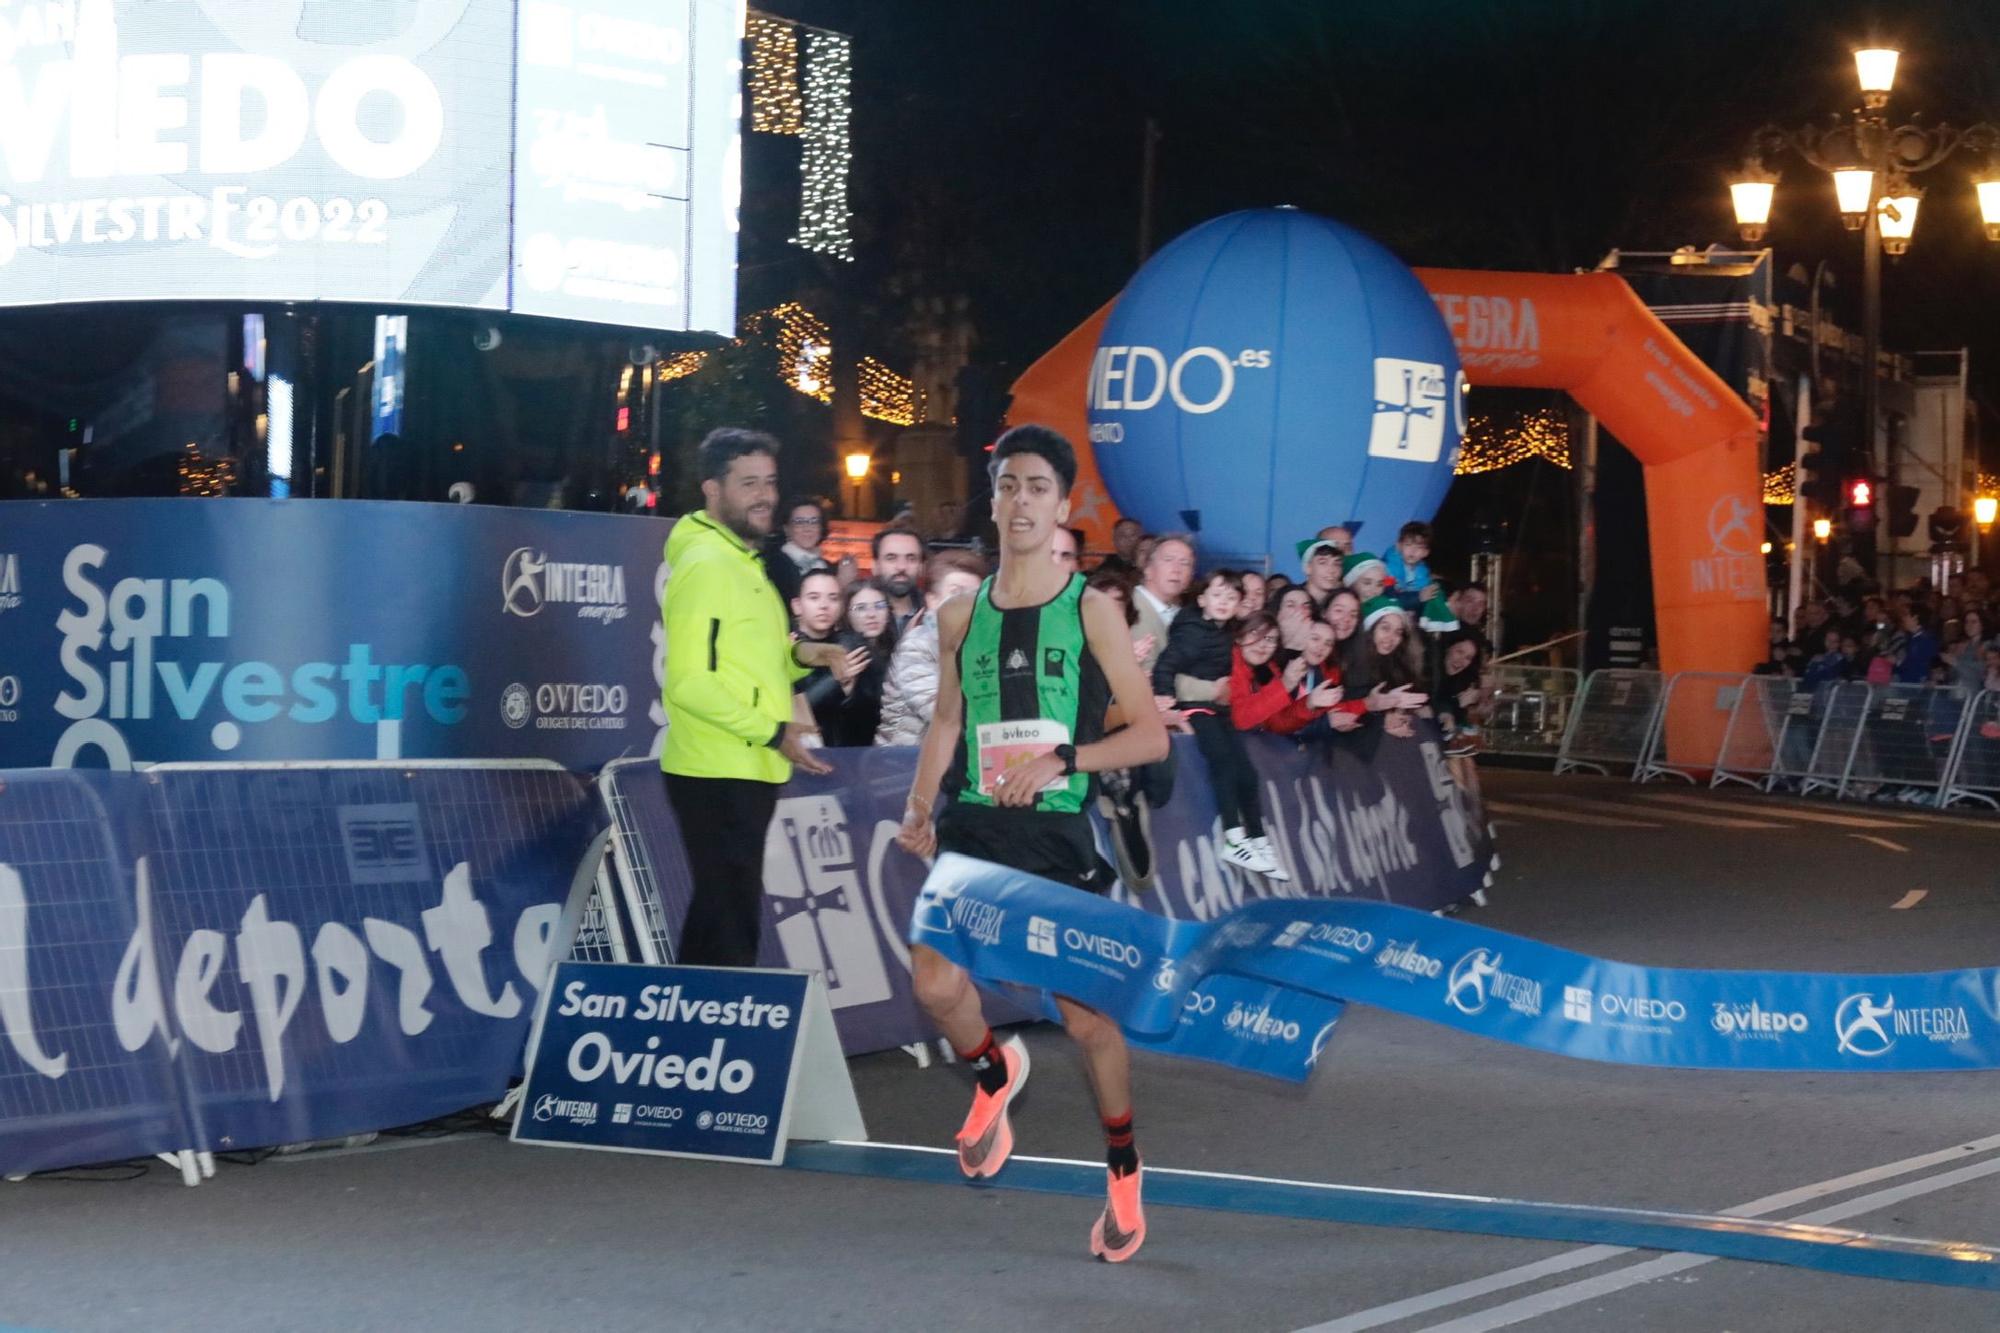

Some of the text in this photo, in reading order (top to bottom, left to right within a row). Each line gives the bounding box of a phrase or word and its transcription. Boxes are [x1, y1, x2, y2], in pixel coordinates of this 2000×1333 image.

[55, 543, 229, 640] San
[544, 563, 627, 604] INTEGRA
[53, 629, 470, 723] Silvestre
[536, 684, 628, 714] OVIEDO
[953, 896, 1006, 939] INTEGRA
[1064, 928, 1141, 969] OVIEDO
[1309, 923, 1374, 953] OVIEDO
[558, 980, 790, 1029] San Silvestre
[1490, 971, 1543, 1011] INTEGRA
[1600, 994, 1687, 1022] OVIEDO
[1894, 1006, 1970, 1036] INTEGRA
[567, 1031, 754, 1094] Oviedo
[555, 1100, 598, 1119] INTEGRA
[636, 1104, 683, 1120] OVIEDO
[716, 1111, 768, 1129] OVIEDO
